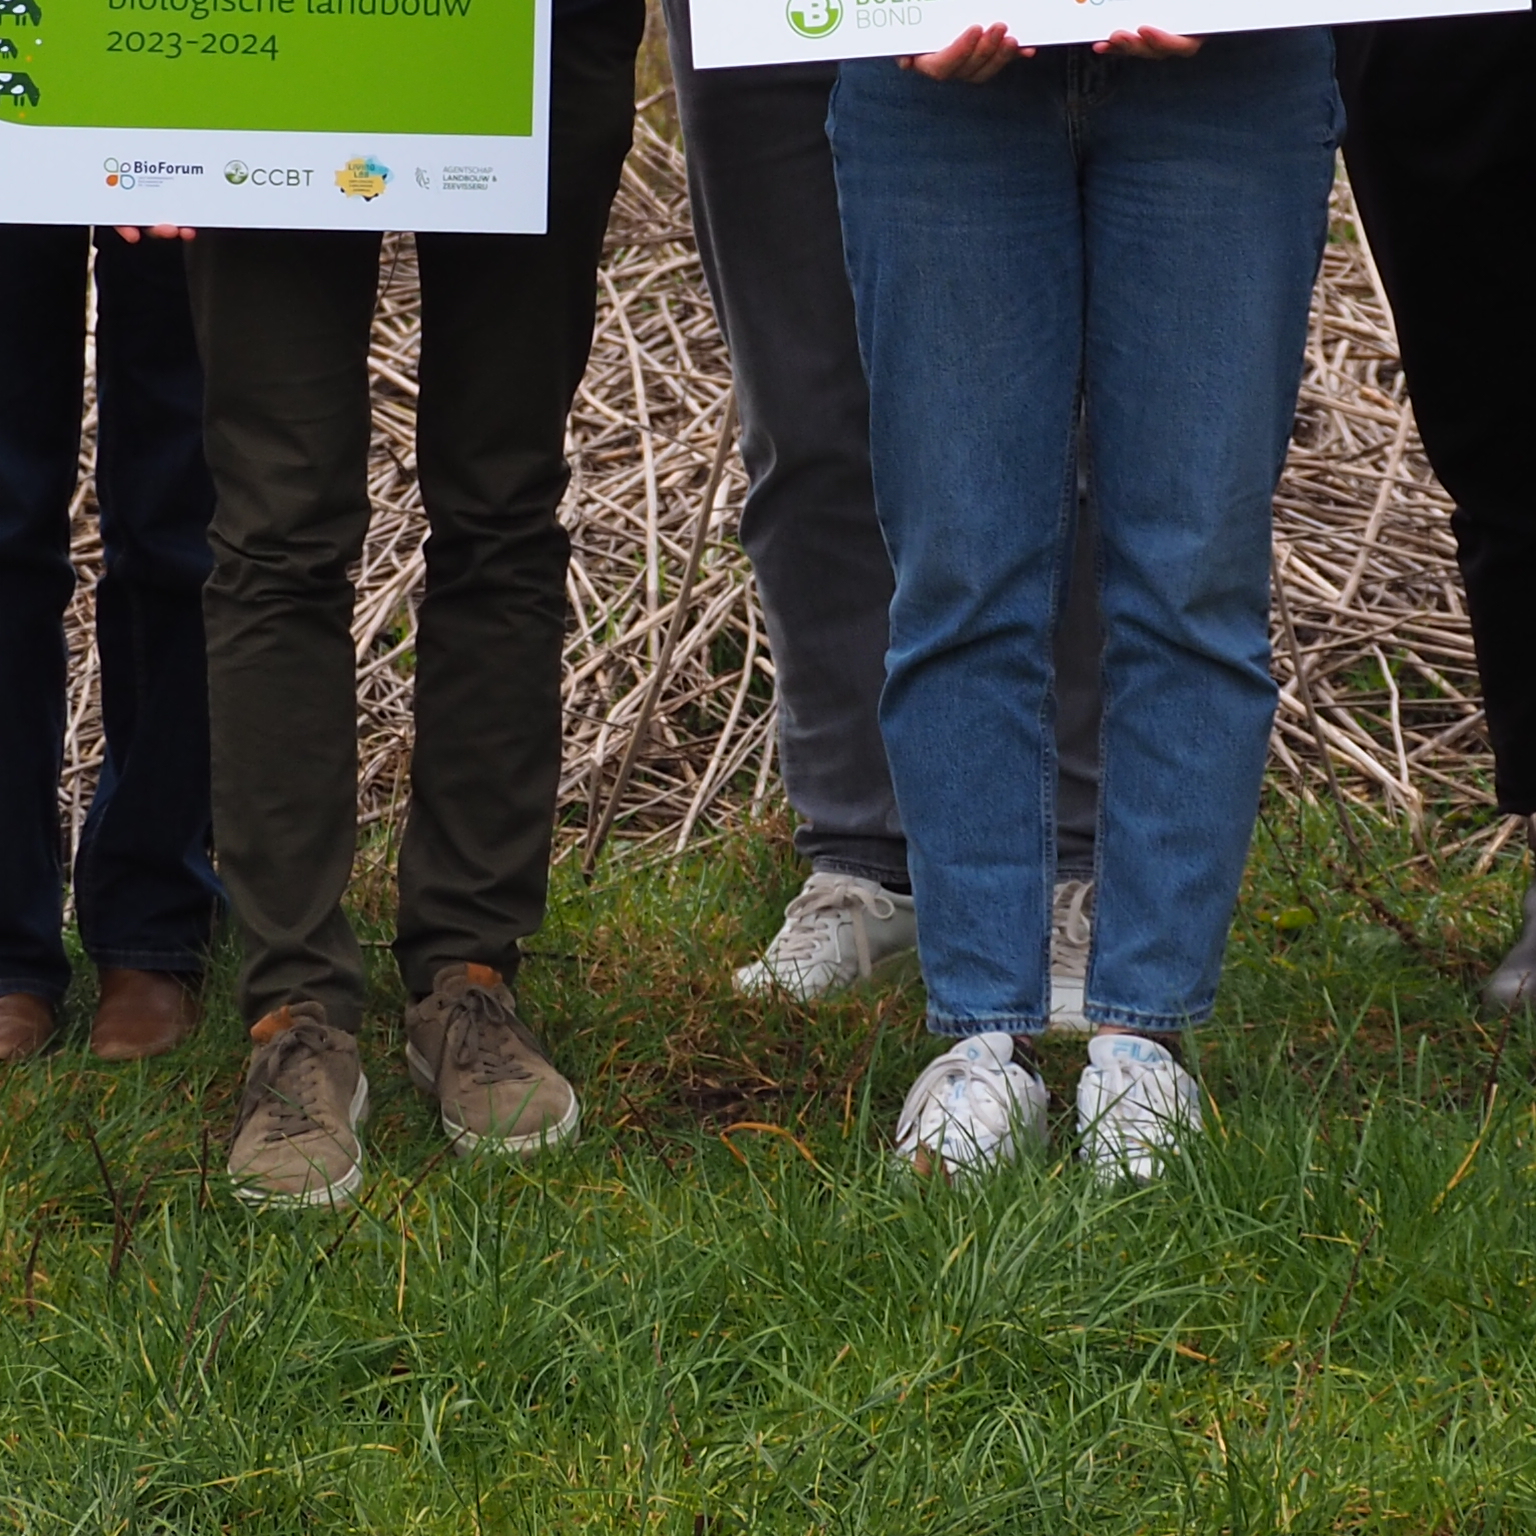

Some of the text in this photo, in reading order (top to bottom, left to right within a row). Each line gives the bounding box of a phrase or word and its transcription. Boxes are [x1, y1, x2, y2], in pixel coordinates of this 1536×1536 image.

[856, 6, 923, 30] BOND
[106, 30, 280, 62] 2023-2024
[133, 161, 204, 175] BioForum
[251, 168, 315, 187] CCBT
